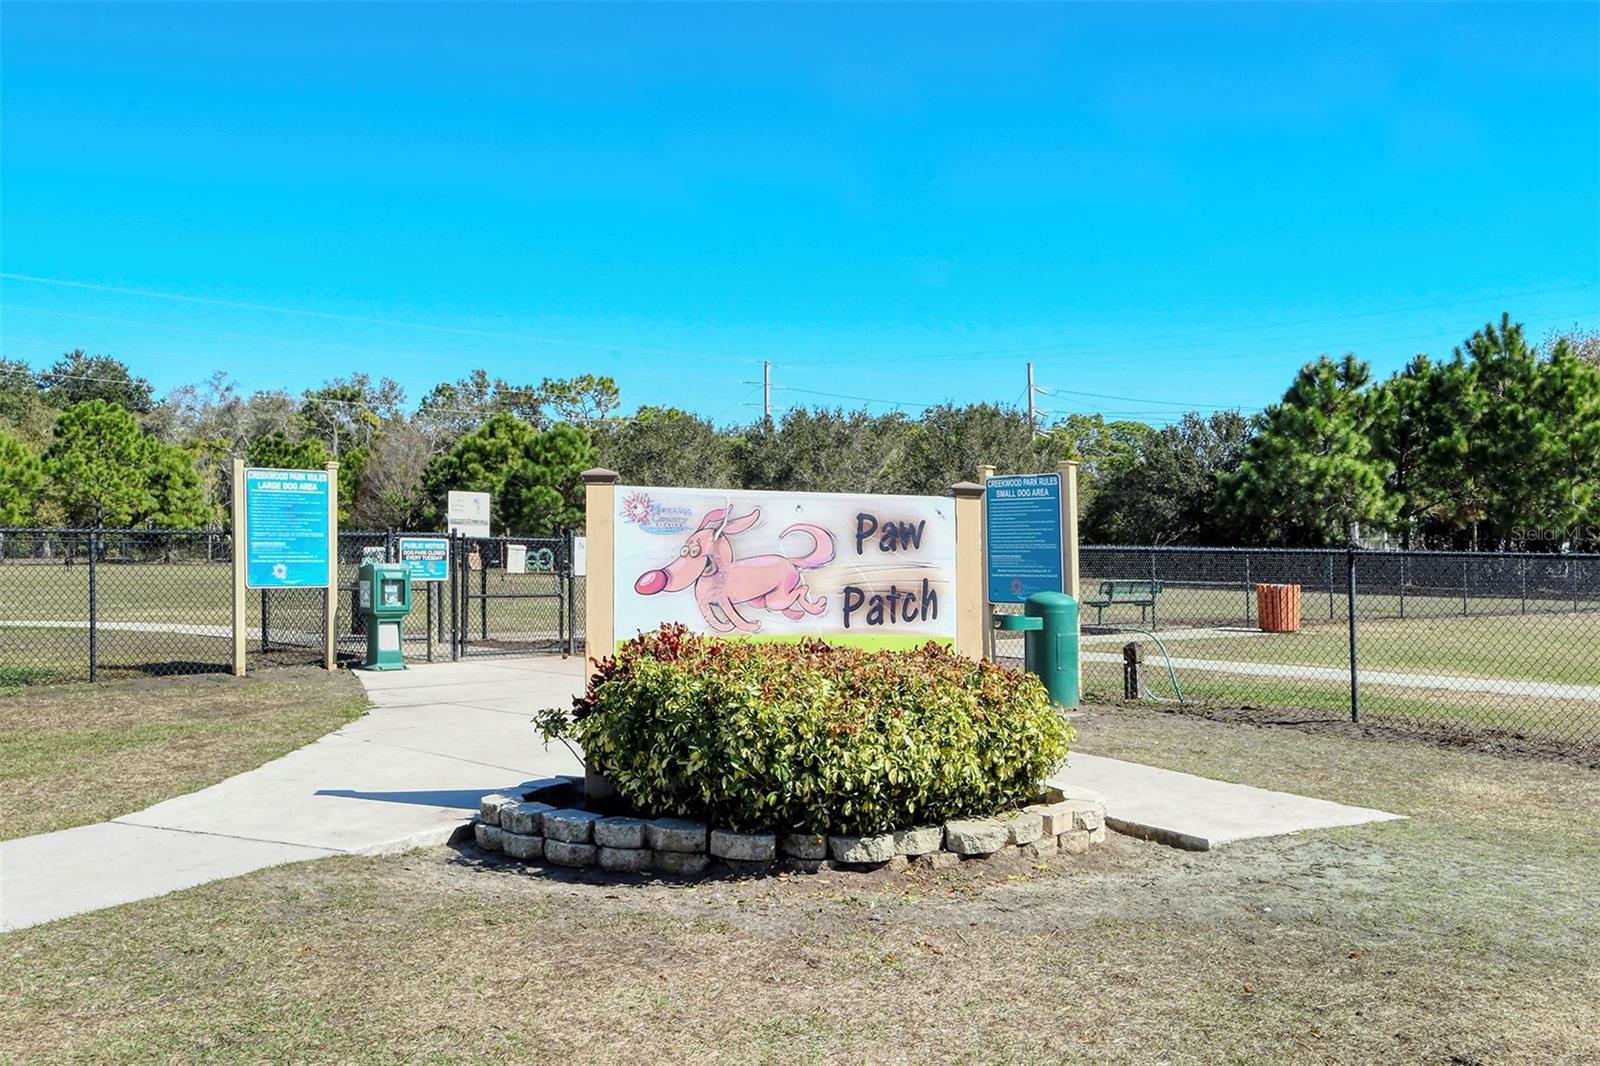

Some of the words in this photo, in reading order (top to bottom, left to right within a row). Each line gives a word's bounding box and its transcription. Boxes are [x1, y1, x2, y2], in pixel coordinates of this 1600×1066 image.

[257, 481, 281, 490] LARGE
[282, 482, 298, 490] DOG
[299, 483, 318, 491] AREA
[987, 479, 1022, 488] CREEKWOOD
[1022, 477, 1038, 487] PARK
[1039, 476, 1058, 486] RULES
[996, 489, 1016, 498] SMALL
[1017, 488, 1031, 497] DOG
[1031, 488, 1049, 497] AREA
[856, 513, 926, 555] Paw
[843, 577, 938, 629] Patch
